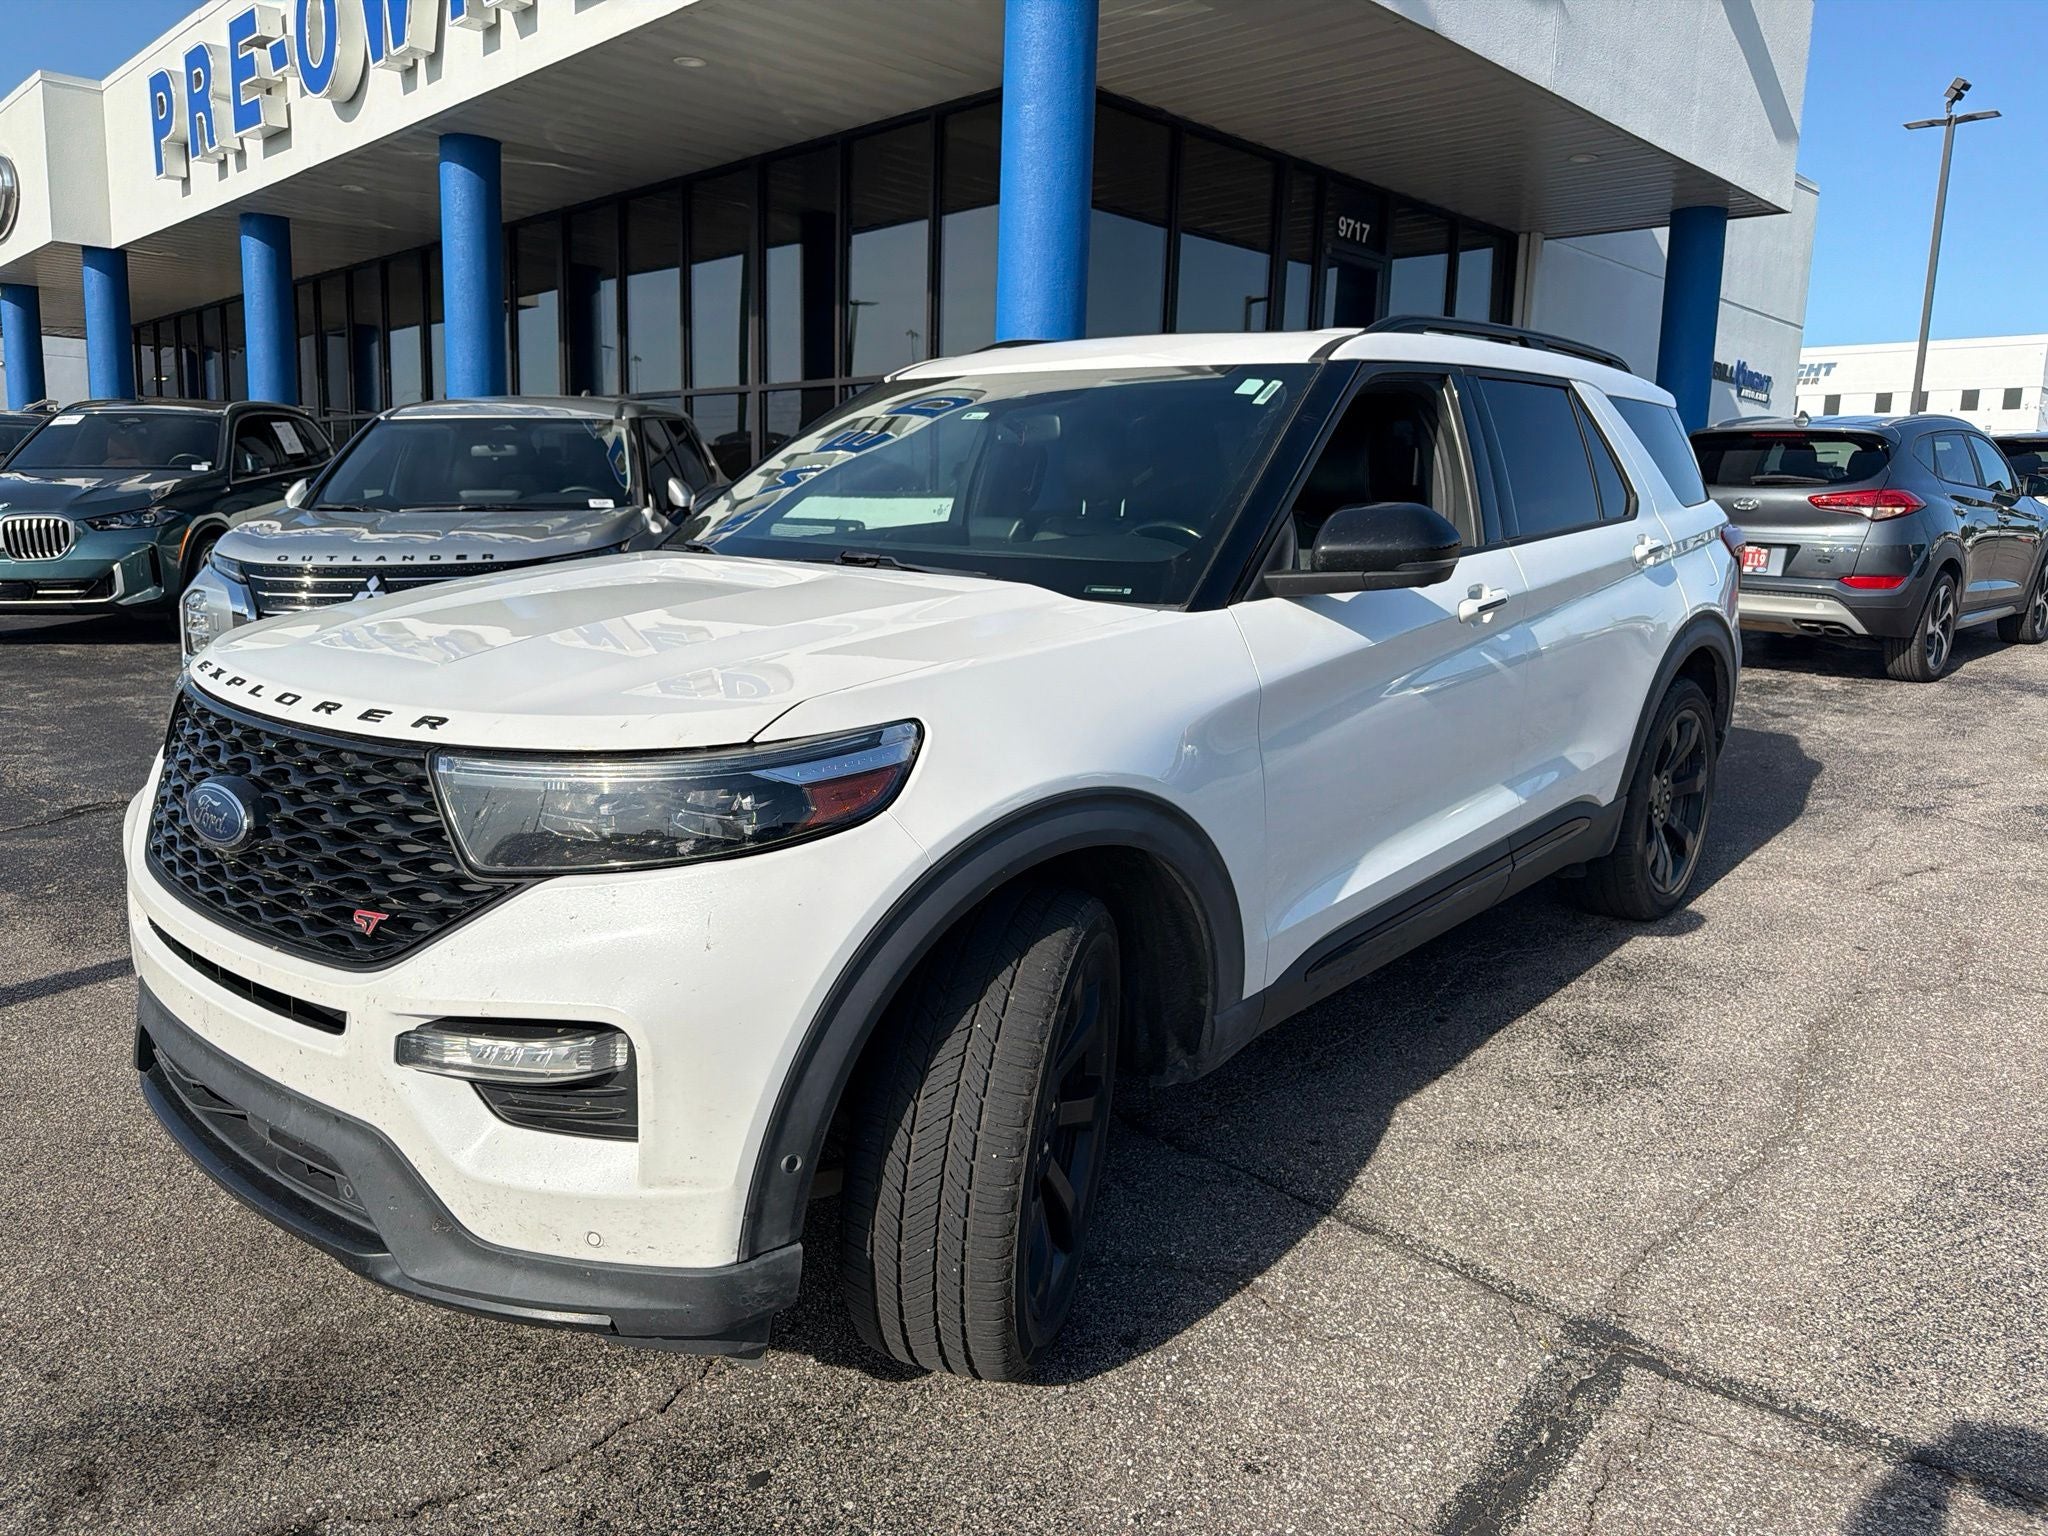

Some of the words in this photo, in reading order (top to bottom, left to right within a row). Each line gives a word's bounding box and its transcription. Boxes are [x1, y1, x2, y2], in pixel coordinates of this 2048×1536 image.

[1338, 215, 1370, 243] 9717
[1712, 361, 1736, 385] BILL
[276, 553, 495, 562] OUTLANDER
[197, 660, 450, 731] EXPLORER
[193, 794, 228, 834] Ford
[353, 909, 390, 938] ST
